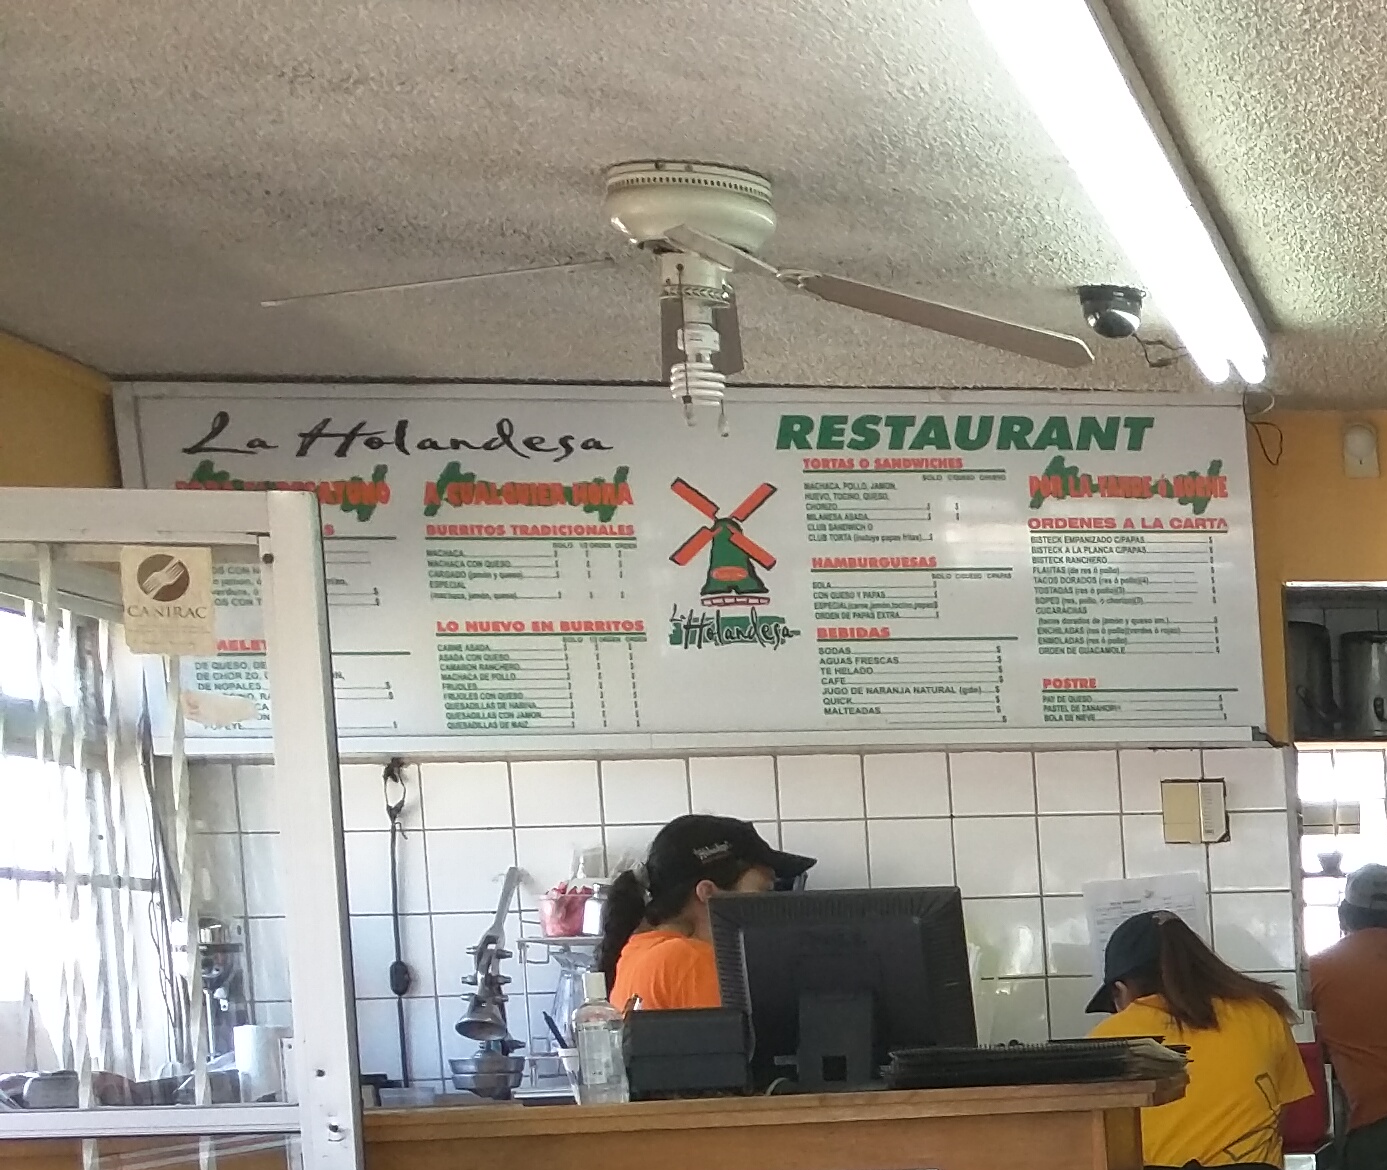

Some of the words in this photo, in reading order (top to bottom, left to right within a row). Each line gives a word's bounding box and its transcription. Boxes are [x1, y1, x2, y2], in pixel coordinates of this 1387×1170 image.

[182, 410, 279, 456] La
[296, 417, 615, 461] Holandesa
[775, 414, 1155, 452] RESTAURANT
[803, 457, 855, 469] TORTAS
[858, 457, 871, 469] O
[874, 456, 964, 469] SANDWICHES
[424, 481, 441, 505] A
[571, 481, 635, 505] HORA
[1029, 475, 1063, 499] POR
[1068, 475, 1093, 499] LA
[1027, 517, 1117, 530] ORDENES
[1123, 517, 1135, 530] A
[1141, 517, 1164, 530] LA
[1168, 517, 1228, 530] CARTA
[426, 524, 506, 537] BURRITOS
[510, 524, 635, 537] TRADICIONALES
[812, 556, 937, 568] HAMBURGUESAS
[436, 621, 459, 632] LO
[465, 621, 526, 632] NUEVO
[531, 621, 554, 632] EN
[560, 620, 645, 632] BURRITOS
[683, 606, 801, 650] Holandesa
[816, 627, 891, 639] BEBIDAS
[818, 647, 852, 655] SODAS
[819, 657, 853, 665] AGUAS
[854, 656, 900, 665] FRESCAS
[834, 667, 874, 675] HELADO
[1043, 678, 1096, 689] POSTRE
[822, 687, 848, 695] JUGO
[850, 687, 864, 695] DE
[865, 686, 911, 695] NARANJA
[913, 686, 957, 694] NATURAL
[823, 707, 882, 716] MALTEADAS
